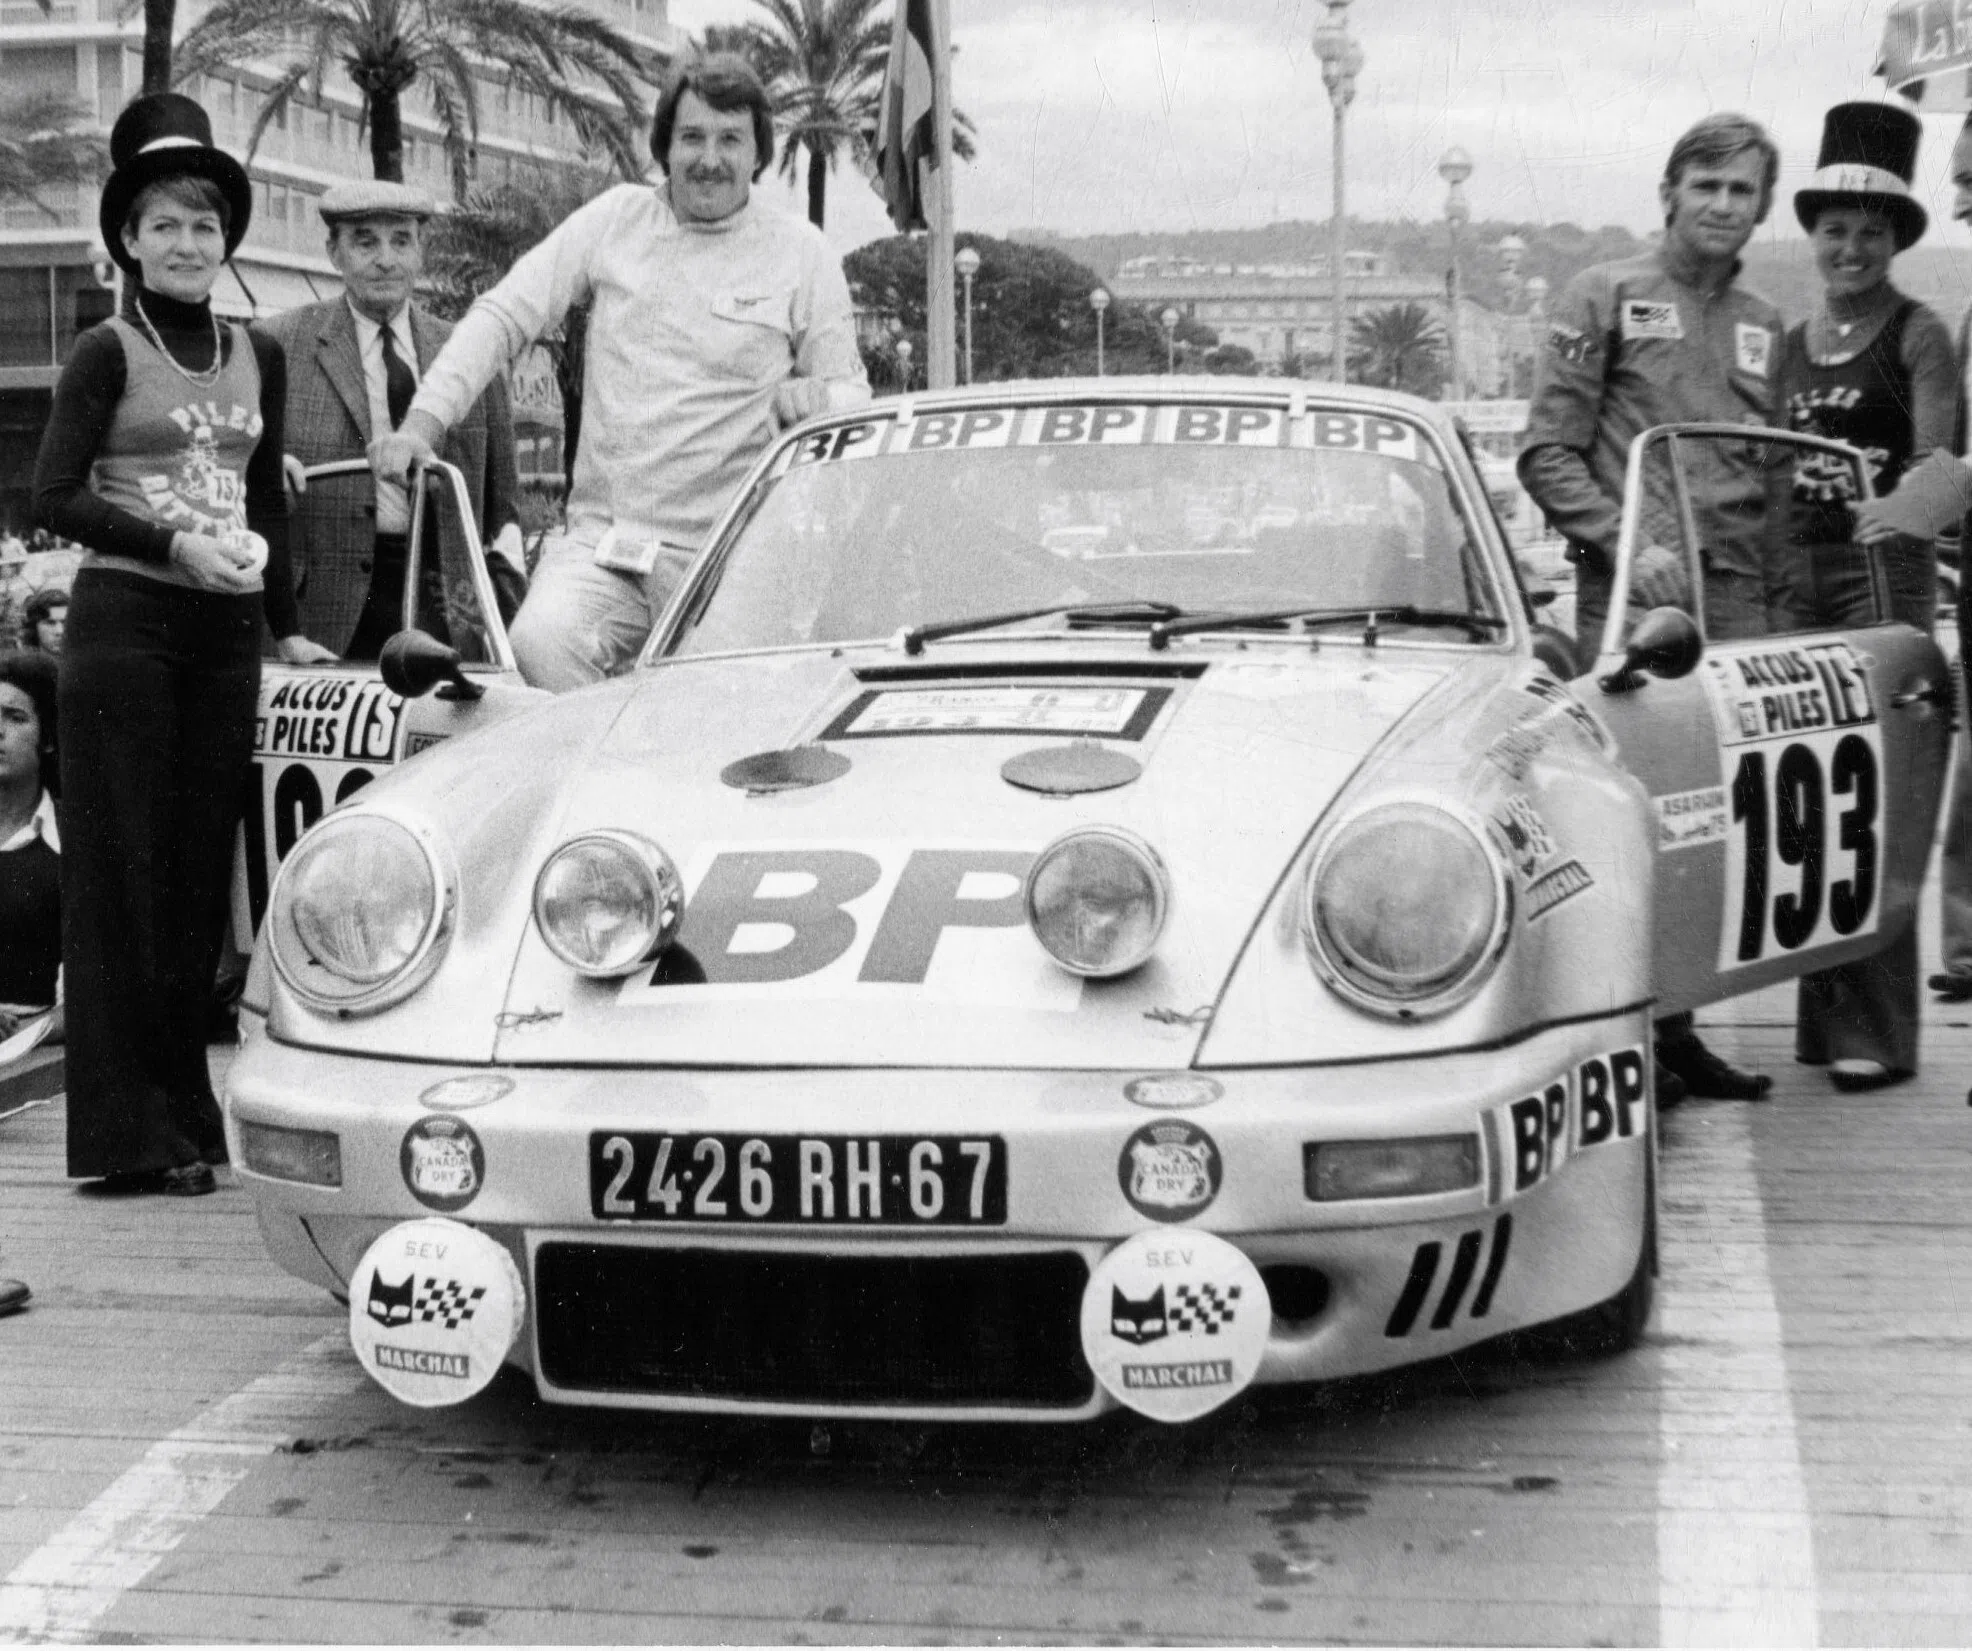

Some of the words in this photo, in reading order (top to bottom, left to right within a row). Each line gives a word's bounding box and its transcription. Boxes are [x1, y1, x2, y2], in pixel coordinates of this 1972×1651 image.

[788, 424, 877, 468] BP
[909, 412, 1004, 451] BP
[1039, 408, 1136, 444] BP
[1174, 408, 1271, 445] BP
[1313, 413, 1407, 452] BP
[1736, 650, 1814, 688] ACCUS
[270, 679, 357, 711] ACCUS
[1761, 688, 1826, 734] PILES
[272, 716, 338, 755] PILES
[350, 680, 402, 757] TS
[1732, 734, 1878, 962] 193
[650, 849, 1036, 986] BP
[1510, 1083, 1565, 1191] BP
[1579, 1050, 1644, 1147] BP
[420, 1155, 468, 1167] CANADA
[431, 1169, 455, 1182] DRY
[1140, 1161, 1202, 1176] CANADA
[1156, 1178, 1184, 1191] DRY
[377, 1346, 466, 1377] MARCHAL
[1127, 1362, 1227, 1386] MARCHAL
